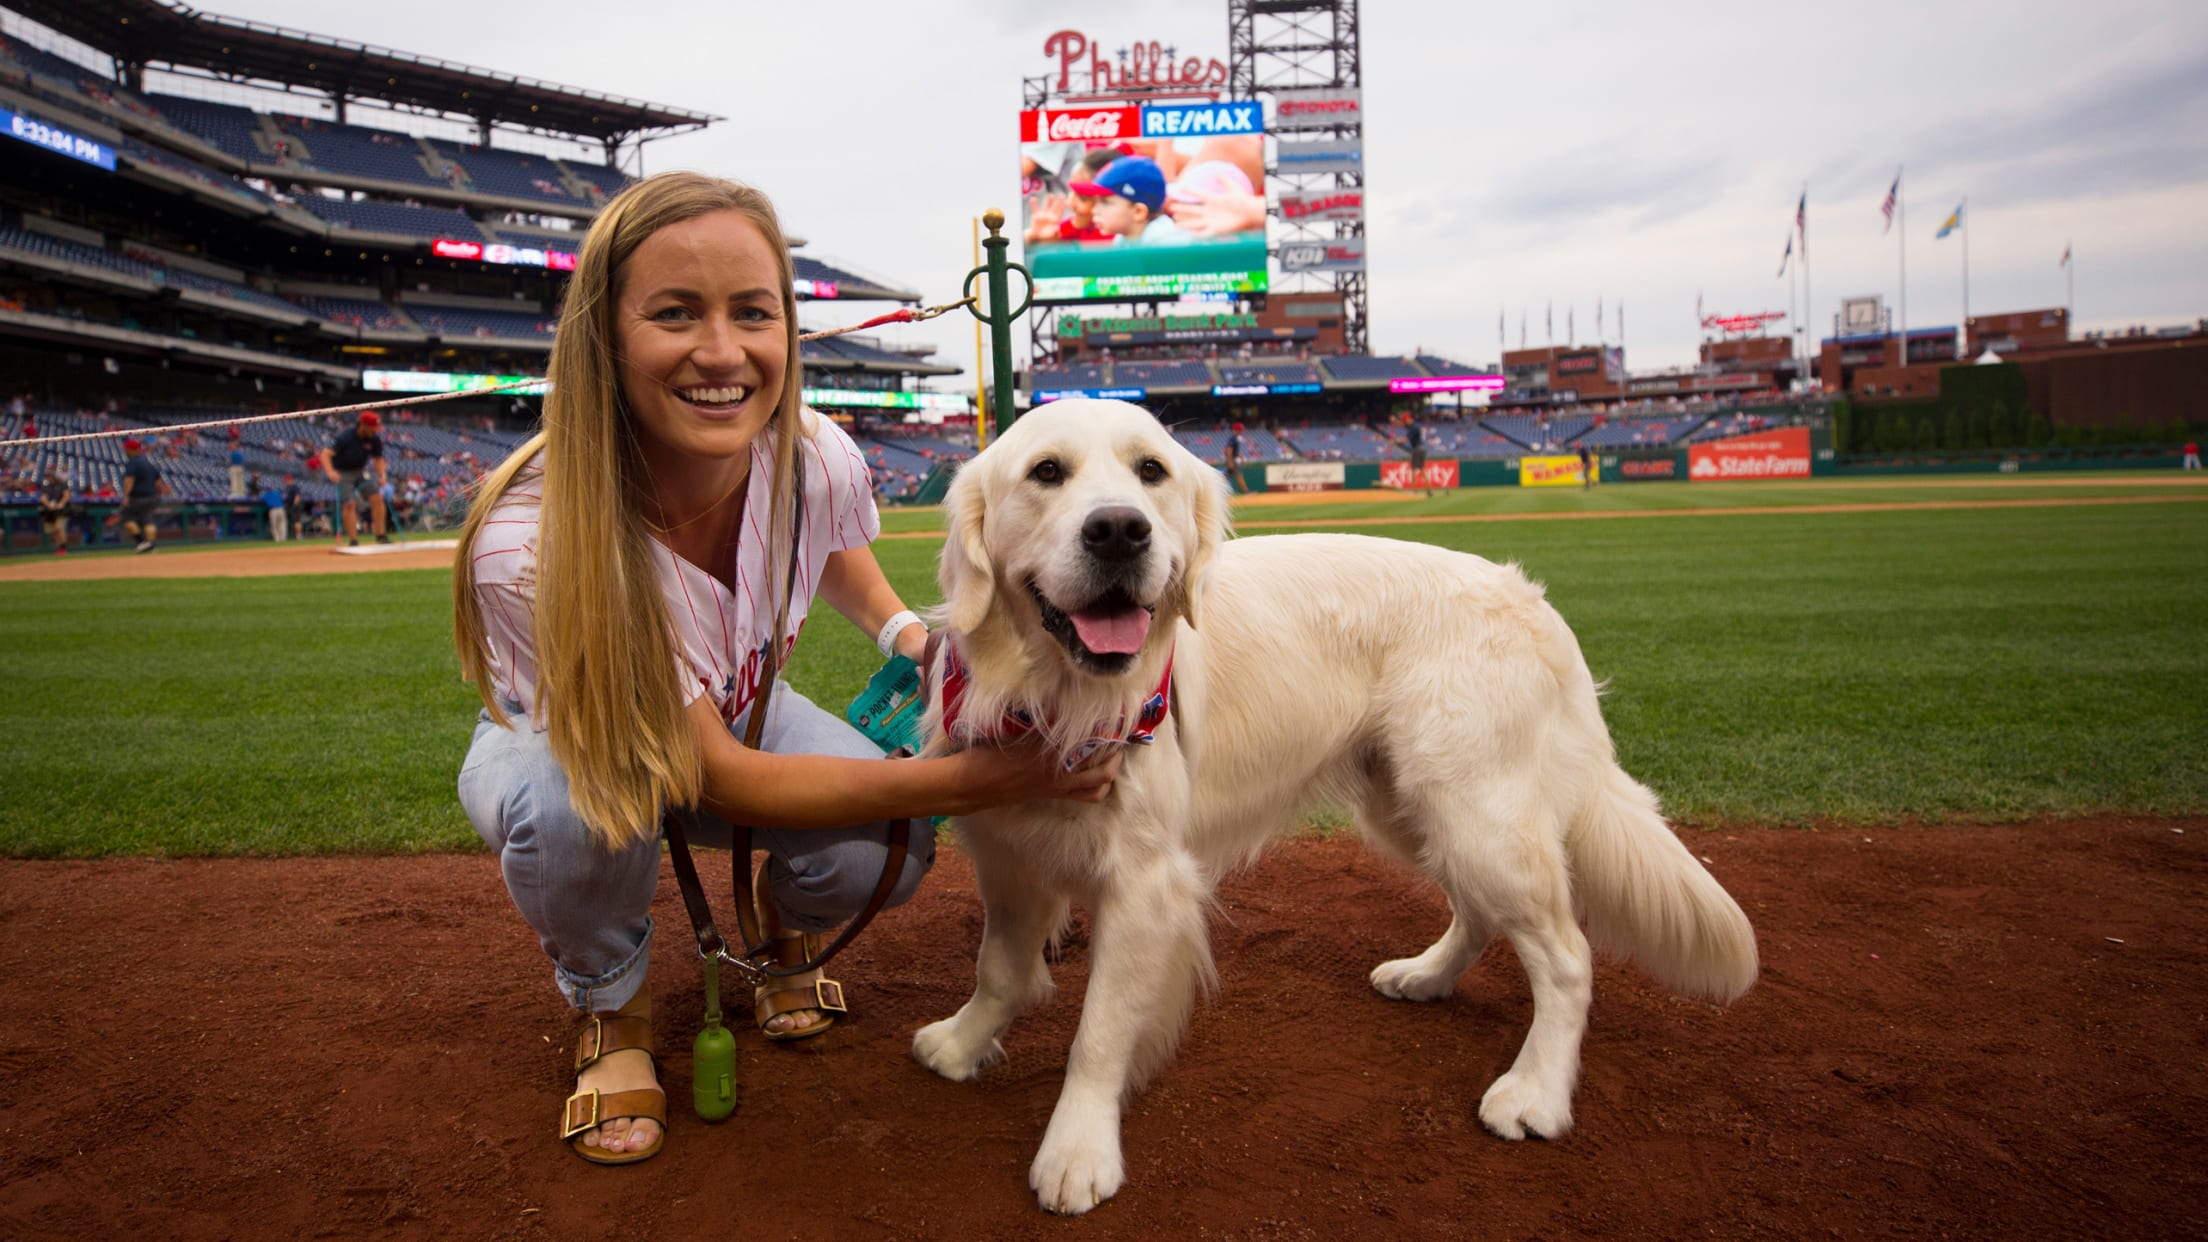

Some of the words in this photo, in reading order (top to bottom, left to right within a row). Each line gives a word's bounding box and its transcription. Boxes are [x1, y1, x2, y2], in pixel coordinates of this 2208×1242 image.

[1044, 29, 1228, 92] Phillies
[1298, 99, 1359, 114] TOYOTA
[1050, 111, 1123, 139] Coca-Cola
[1146, 107, 1253, 135] RE/MAX
[12, 116, 73, 153] 6:33:04
[75, 138, 100, 162] PM
[1087, 316, 1160, 333] Citizens
[1165, 312, 1211, 330] Bank
[1215, 310, 1258, 329] Park
